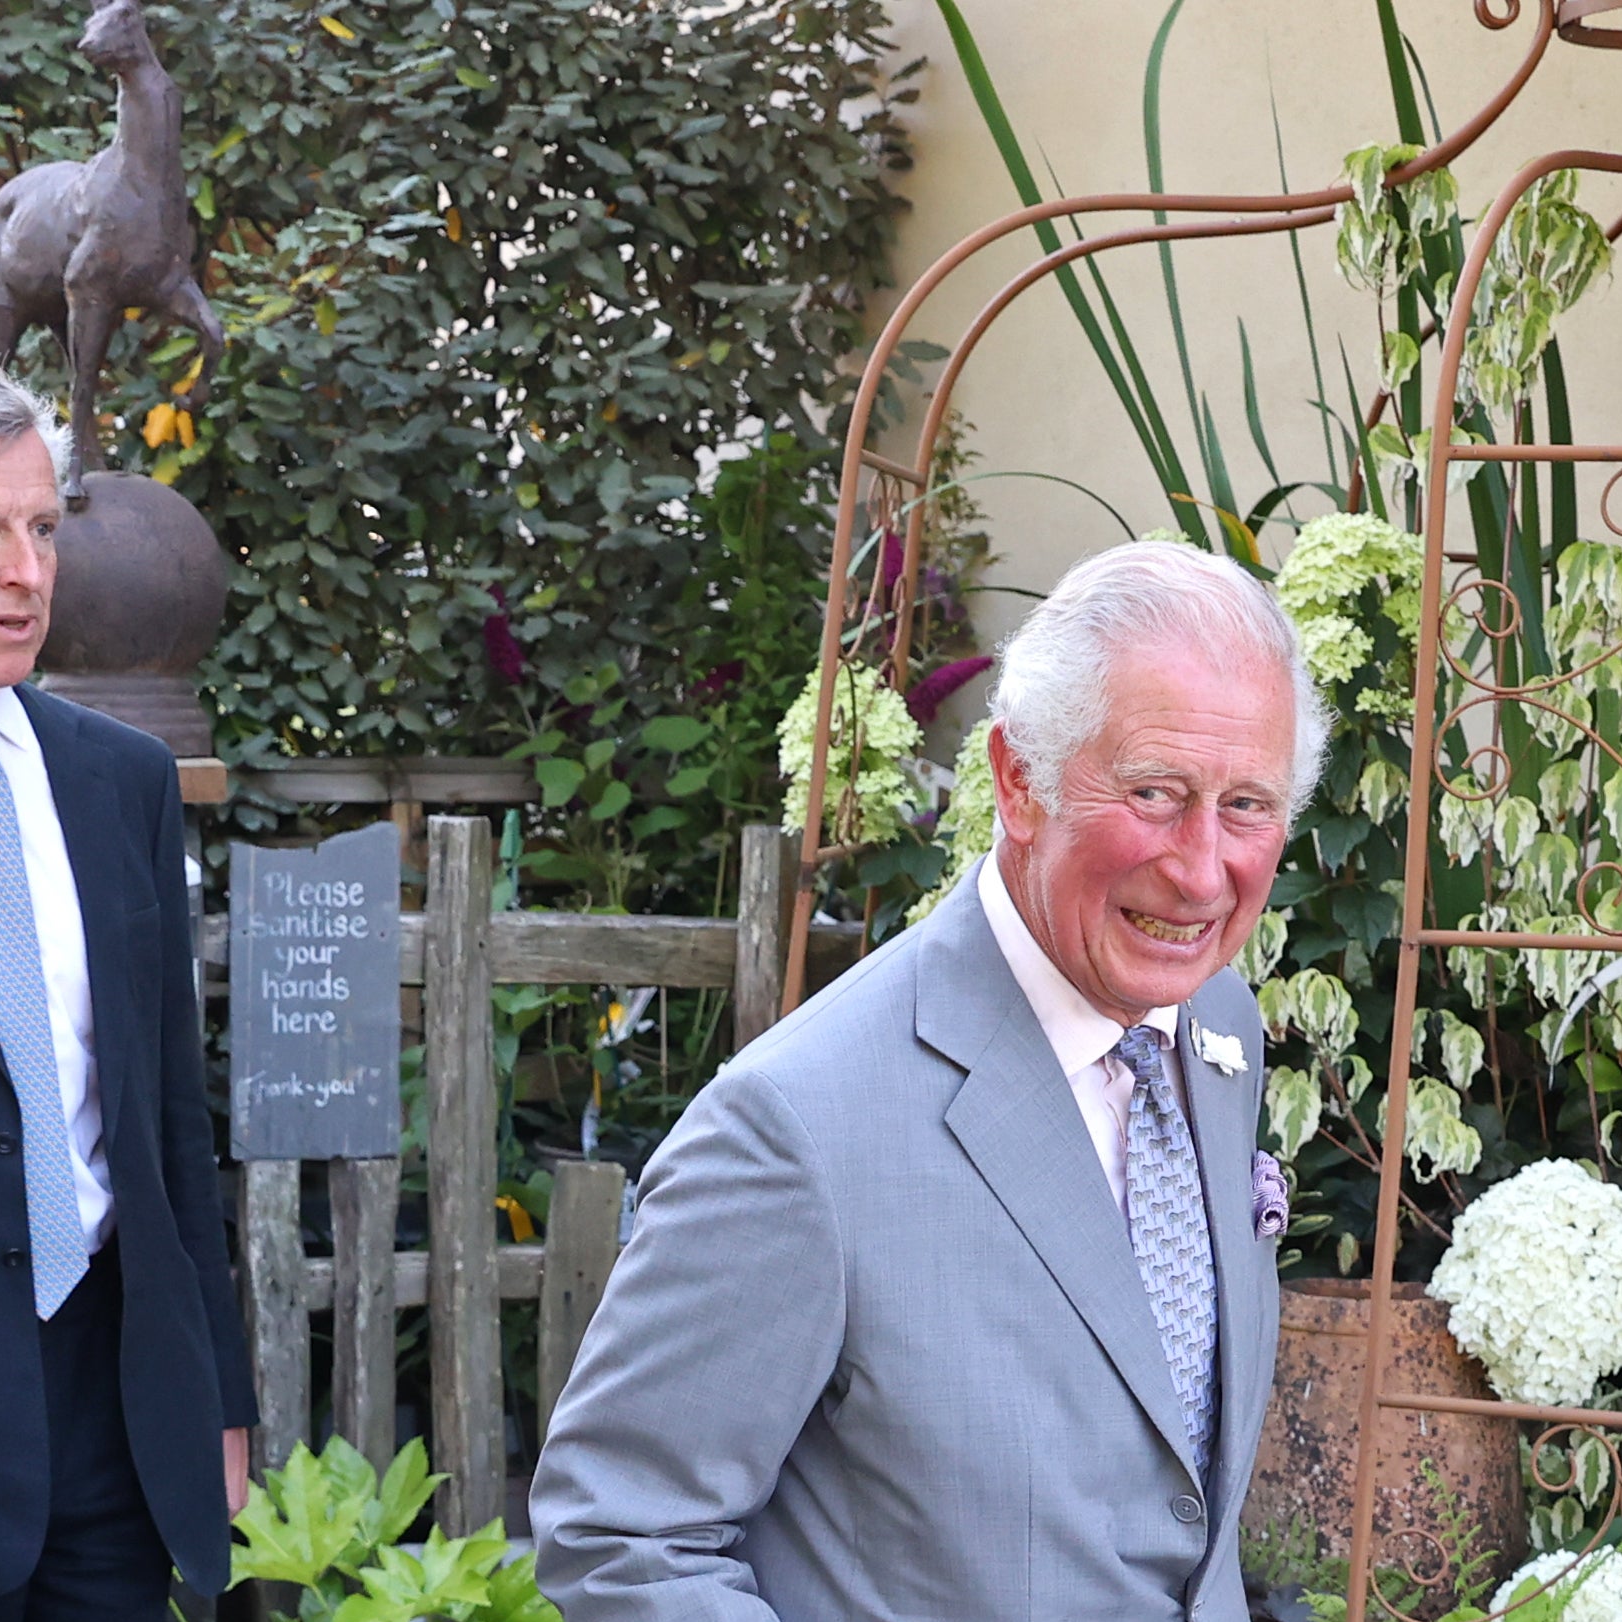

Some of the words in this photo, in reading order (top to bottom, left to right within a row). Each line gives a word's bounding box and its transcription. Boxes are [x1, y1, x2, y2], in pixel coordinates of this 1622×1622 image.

[263, 870, 365, 907] Please
[249, 908, 369, 939] sanitise
[275, 944, 340, 976] your
[261, 967, 350, 1001] hands
[271, 1003, 338, 1034] here
